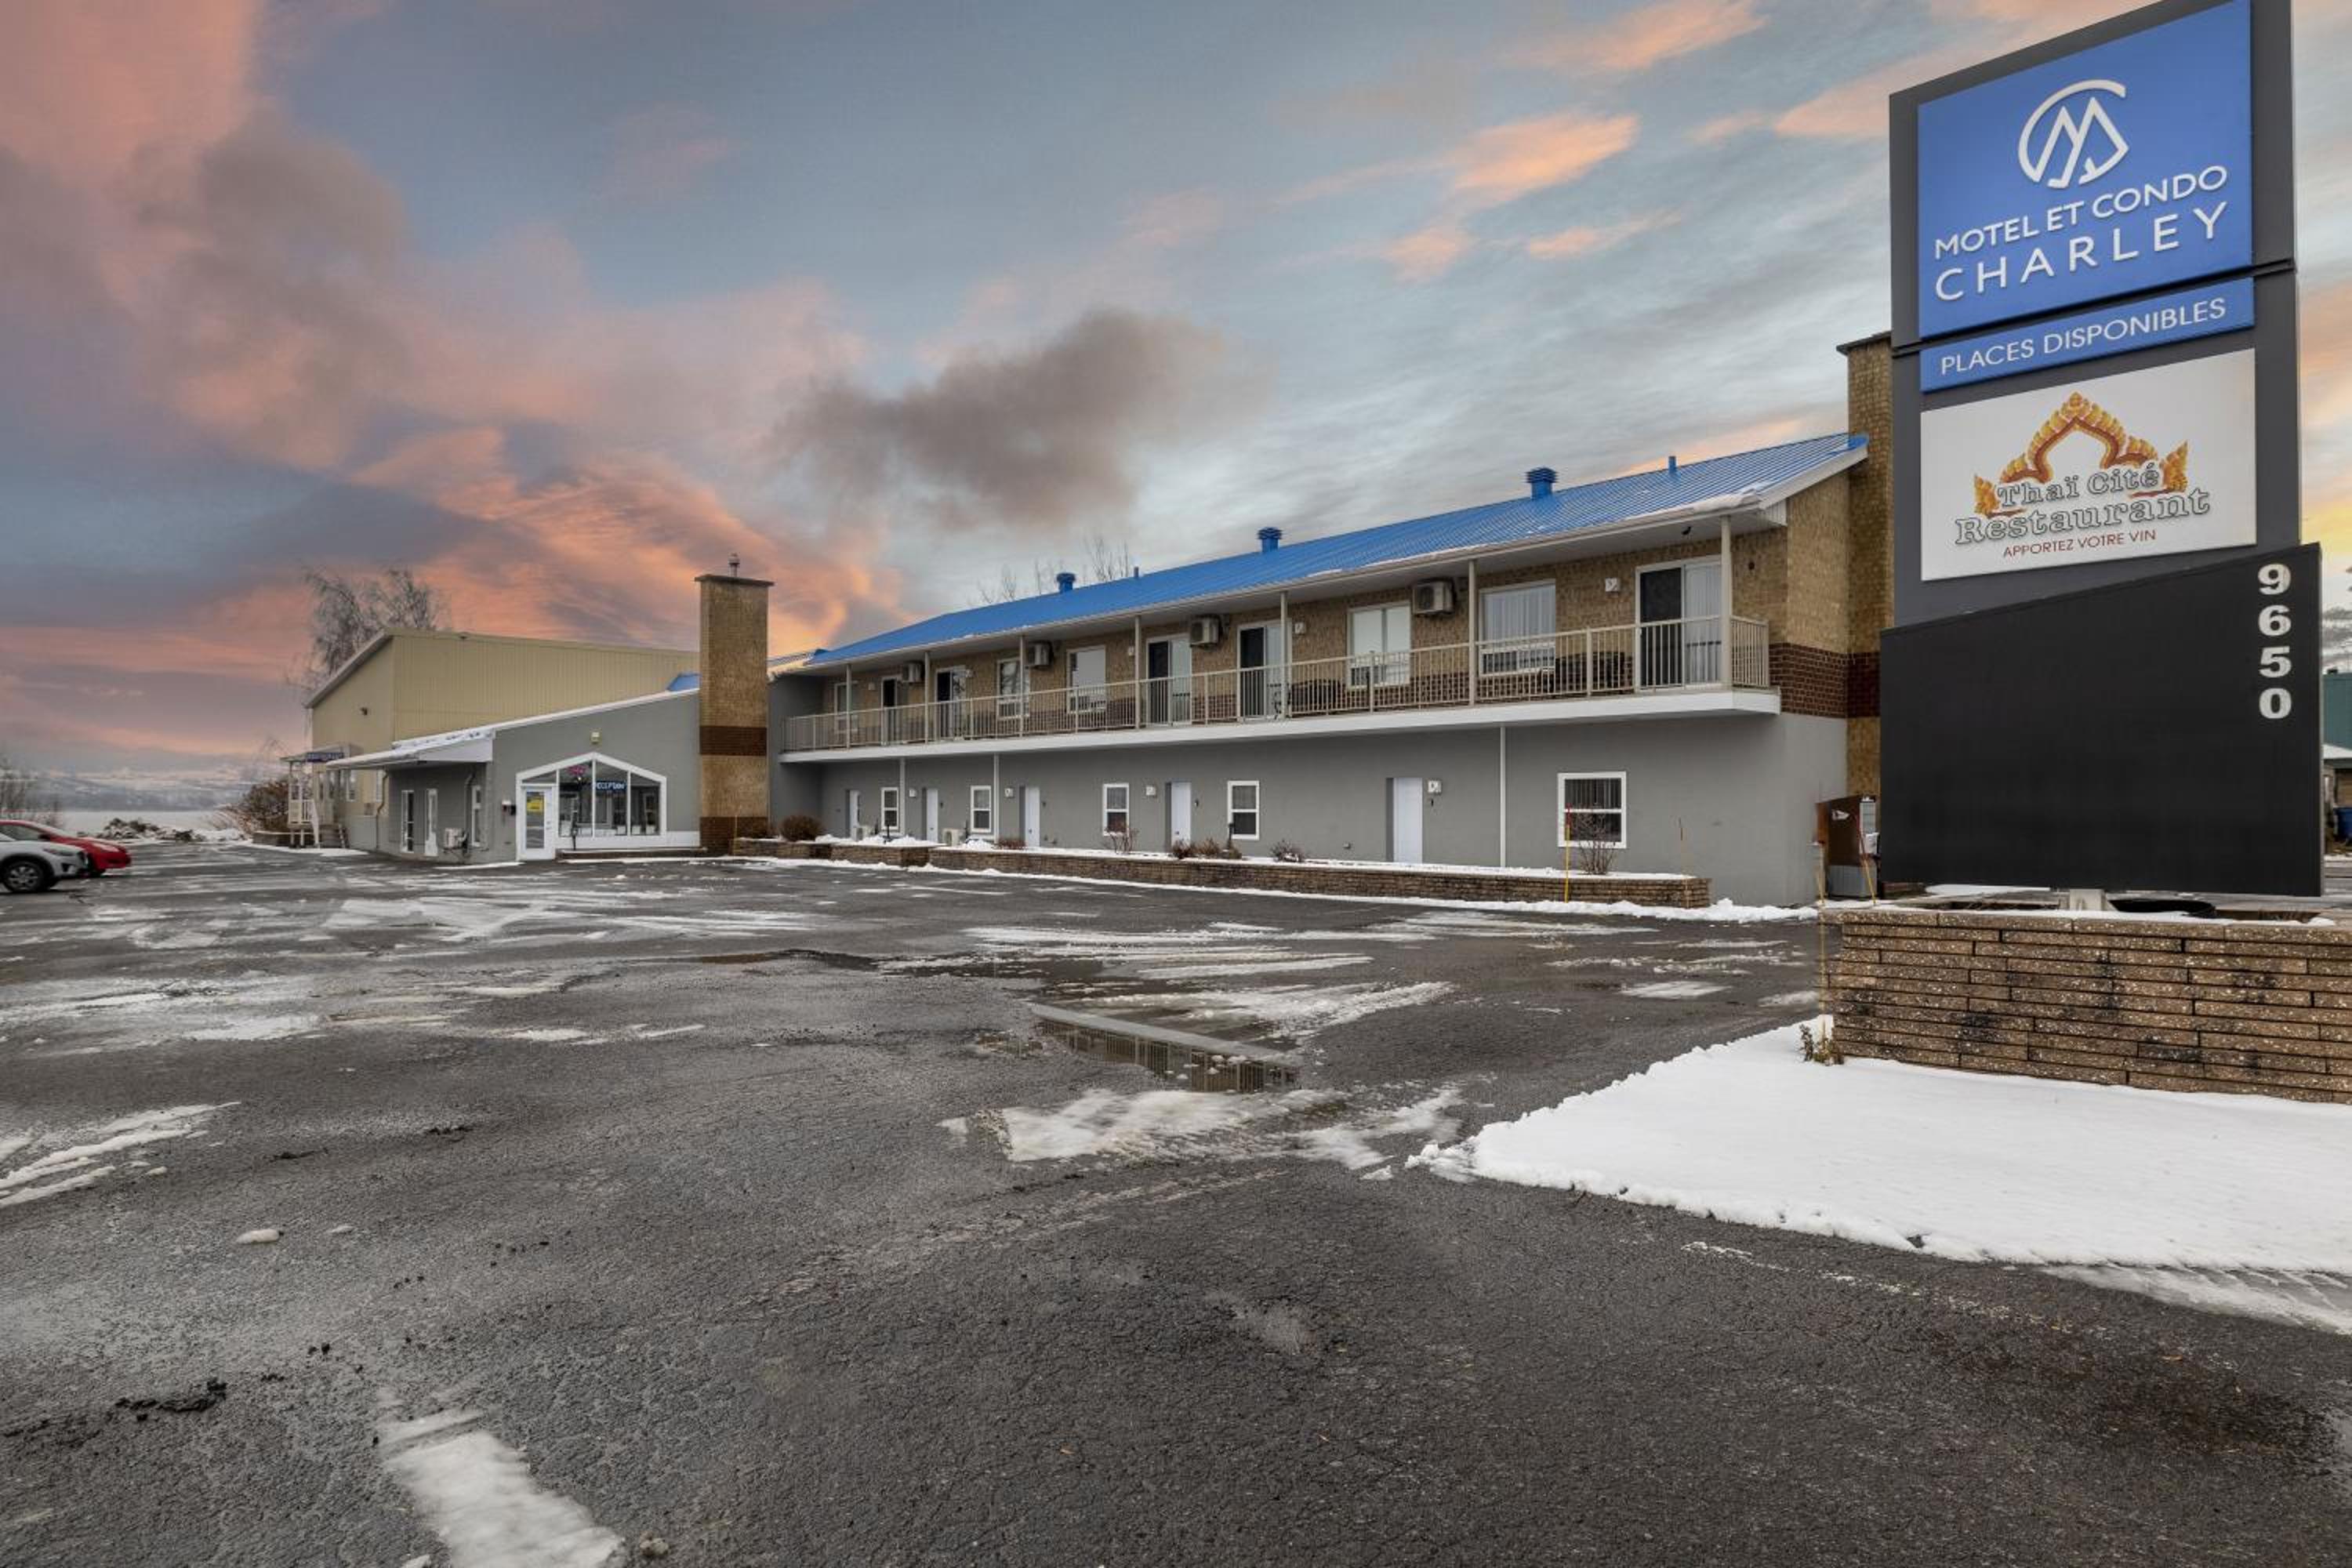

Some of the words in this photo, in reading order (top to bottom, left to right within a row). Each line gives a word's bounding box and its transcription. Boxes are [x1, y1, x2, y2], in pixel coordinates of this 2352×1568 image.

[1935, 216, 2039, 259] MOTEL
[2046, 201, 2084, 231] ET
[2092, 165, 2227, 219] CONDO
[1935, 201, 2227, 301] CHARLEY
[1941, 339, 2034, 376] PLACES
[2044, 298, 2227, 353] DISPONIBLES
[1955, 488, 2210, 545] Restaurant
[1998, 474, 2079, 508] Thaï
[2087, 463, 2159, 495] Cité
[2003, 539, 2074, 557] APPORTEZ
[2129, 528, 2156, 542] VIN
[2258, 563, 2292, 720] 9650
